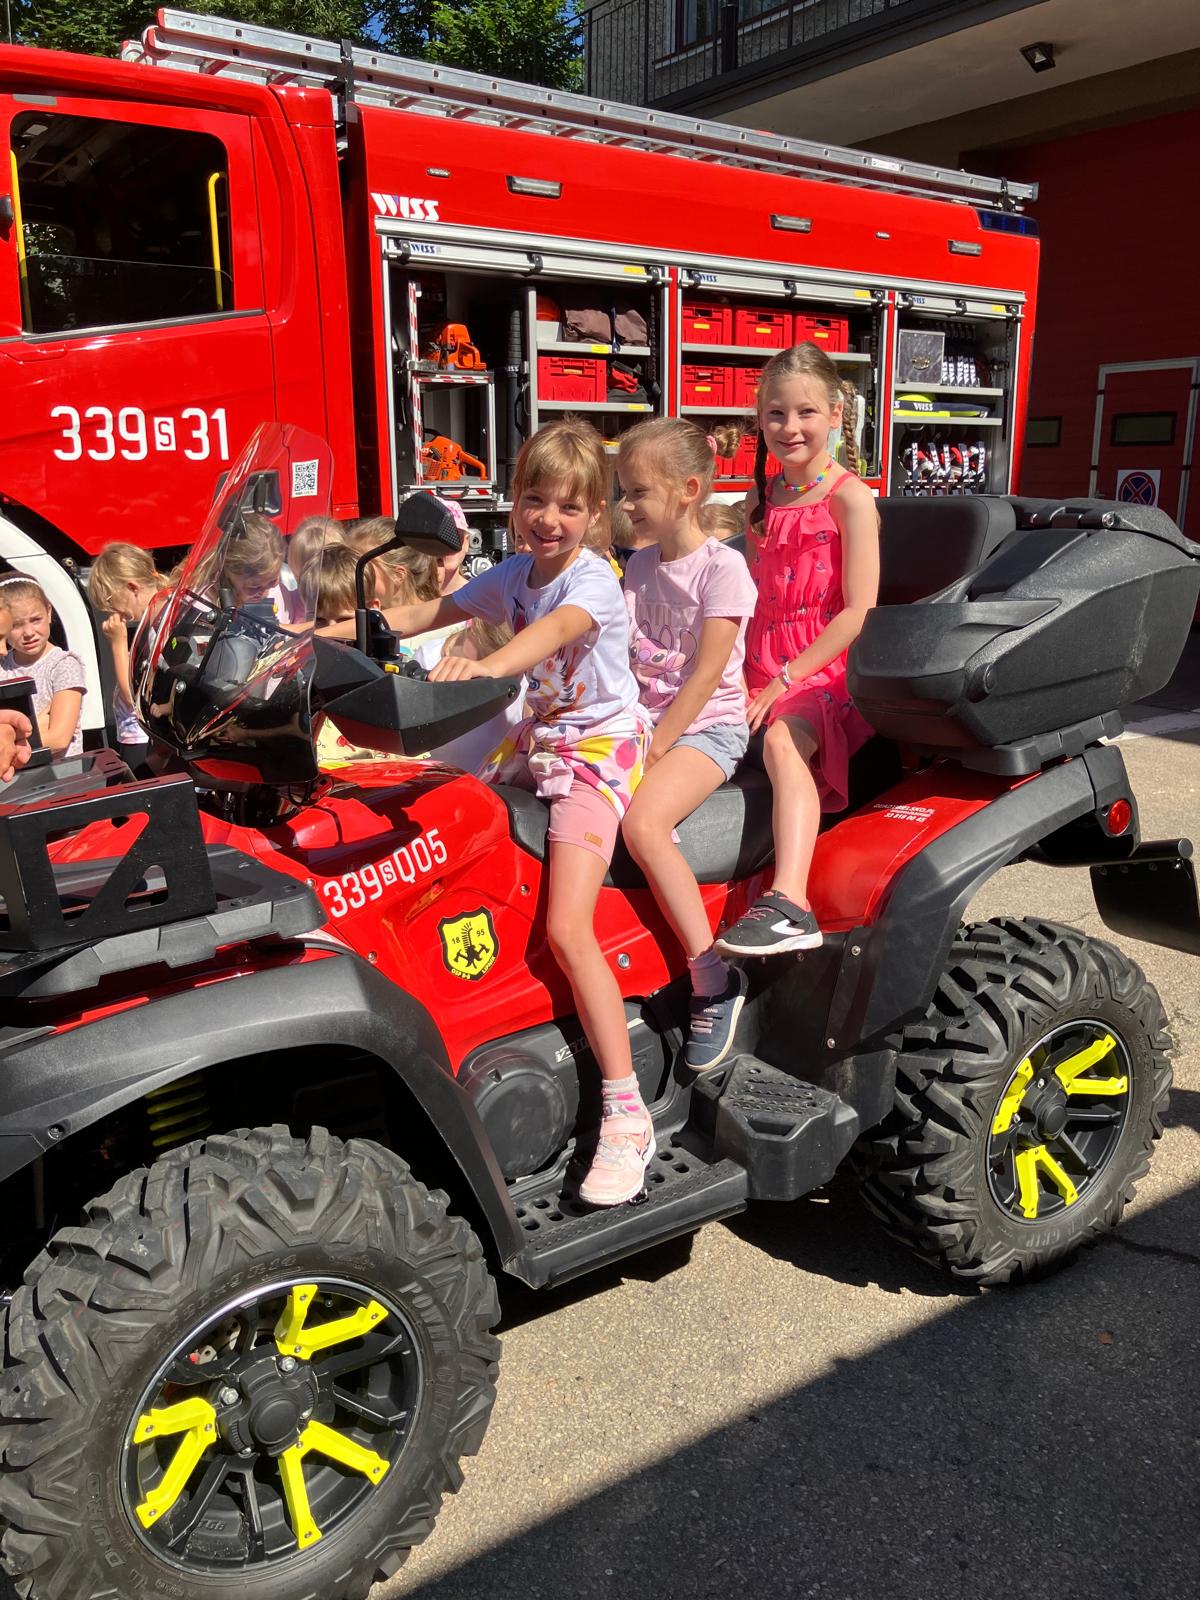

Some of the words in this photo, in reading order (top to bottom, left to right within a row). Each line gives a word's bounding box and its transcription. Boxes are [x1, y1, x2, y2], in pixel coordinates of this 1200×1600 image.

[370, 192, 440, 221] WISS
[410, 243, 436, 254] WISS
[476, 928, 486, 937] 95
[451, 936, 461, 945] 18
